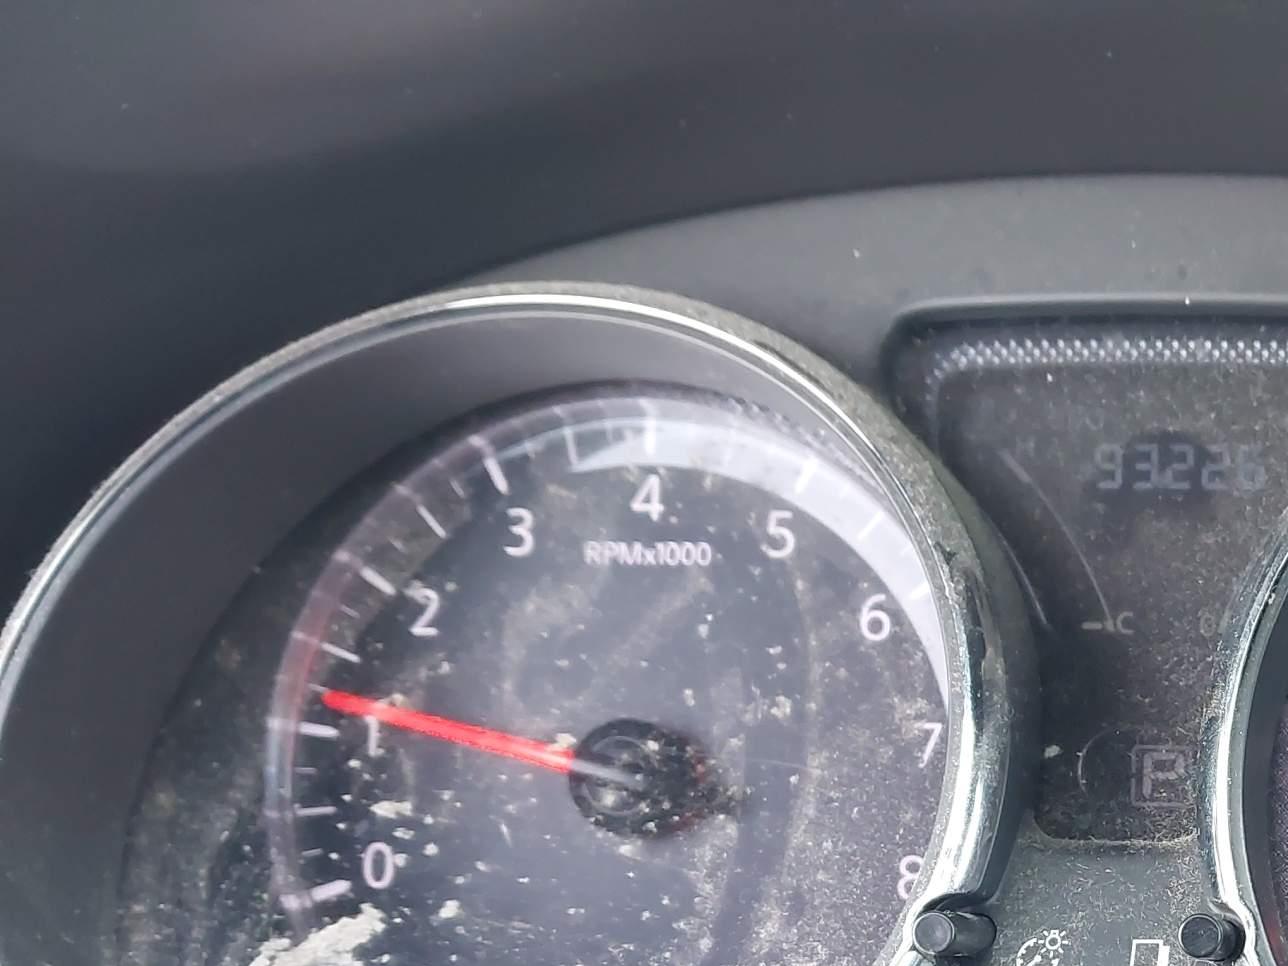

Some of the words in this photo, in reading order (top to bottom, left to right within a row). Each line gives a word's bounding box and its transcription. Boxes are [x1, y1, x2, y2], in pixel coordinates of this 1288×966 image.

[630, 473, 665, 522] 4
[505, 507, 536, 559] 3
[583, 540, 713, 567] RPMx1000
[765, 508, 797, 560] 5
[408, 586, 440, 638] 2
[858, 593, 892, 642] 6
[1115, 611, 1134, 635] C
[916, 721, 943, 769] 7
[1141, 751, 1186, 799] P
[361, 841, 396, 890] 0
[896, 853, 925, 900] 8
